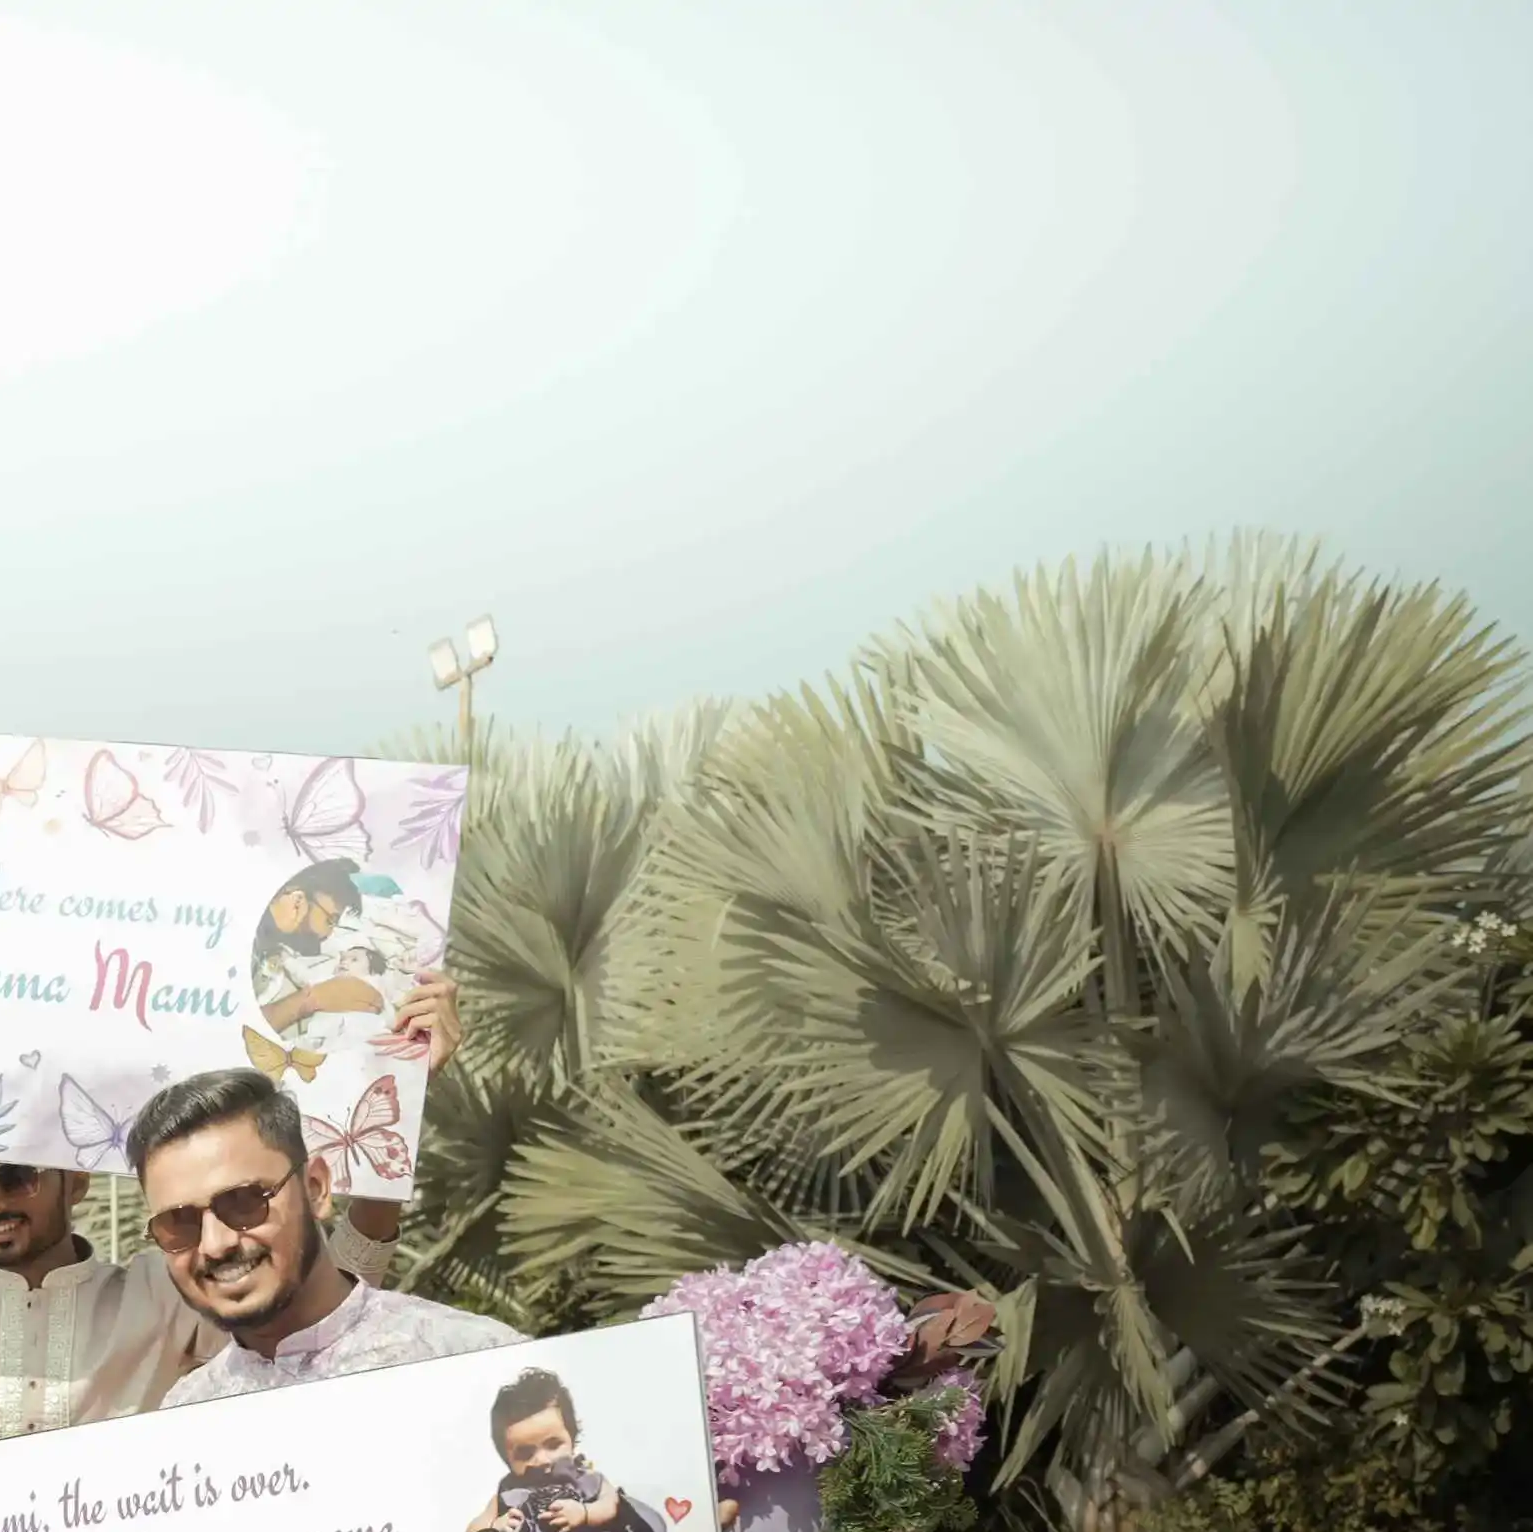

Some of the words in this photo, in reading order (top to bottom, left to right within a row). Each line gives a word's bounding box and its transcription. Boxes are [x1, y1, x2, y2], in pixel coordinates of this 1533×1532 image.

[59, 896, 158, 923] comes
[175, 906, 231, 949] my
[89, 940, 238, 1032] Mami
[58, 1478, 106, 1528] the
[117, 1464, 184, 1520] wait
[194, 1463, 221, 1507] is
[231, 1463, 309, 1501] over.
